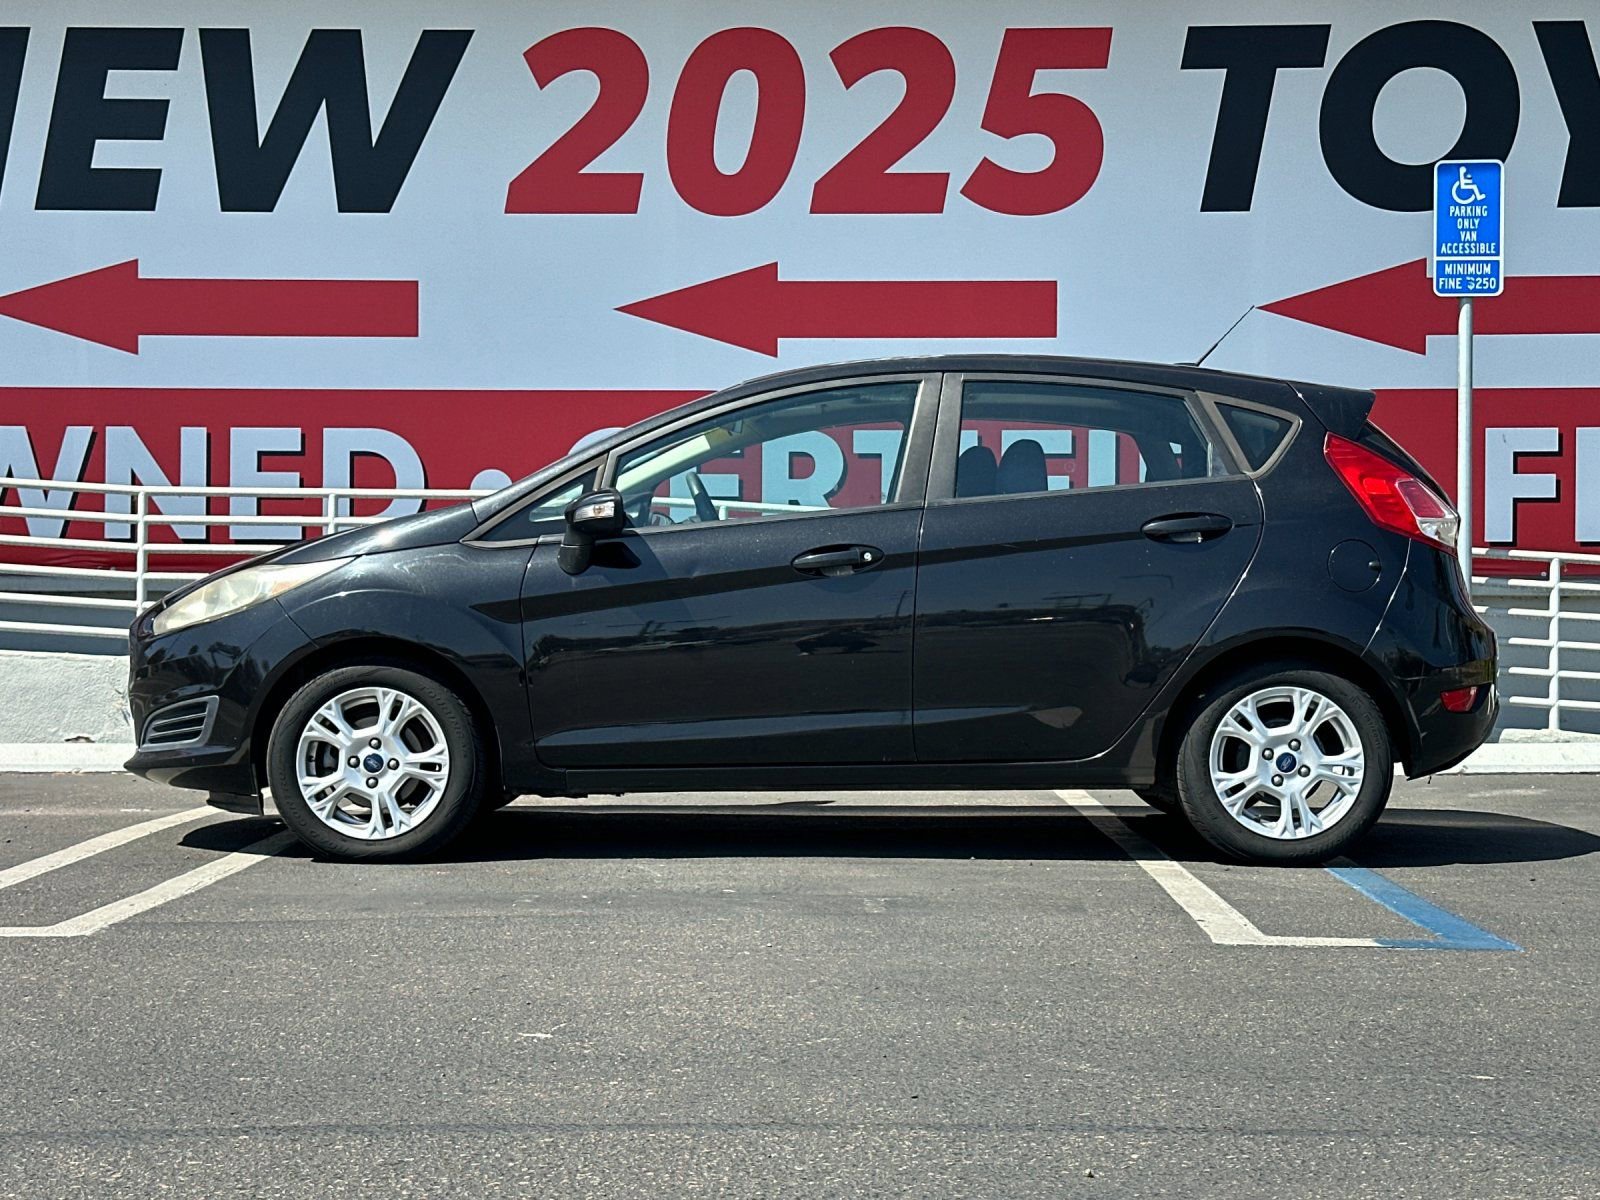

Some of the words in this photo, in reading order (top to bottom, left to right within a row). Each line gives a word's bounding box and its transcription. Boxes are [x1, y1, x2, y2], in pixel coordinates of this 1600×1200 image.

[0, 26, 474, 214] EW
[504, 26, 1113, 217] 2025
[1449, 205, 1488, 217] PARKING
[1457, 218, 1480, 229] ONLY
[1460, 230, 1477, 242] VAN
[1440, 243, 1496, 254] ACCESSIBLE
[1444, 263, 1491, 275] MINIMUM
[1439, 278, 1462, 289] FINE
